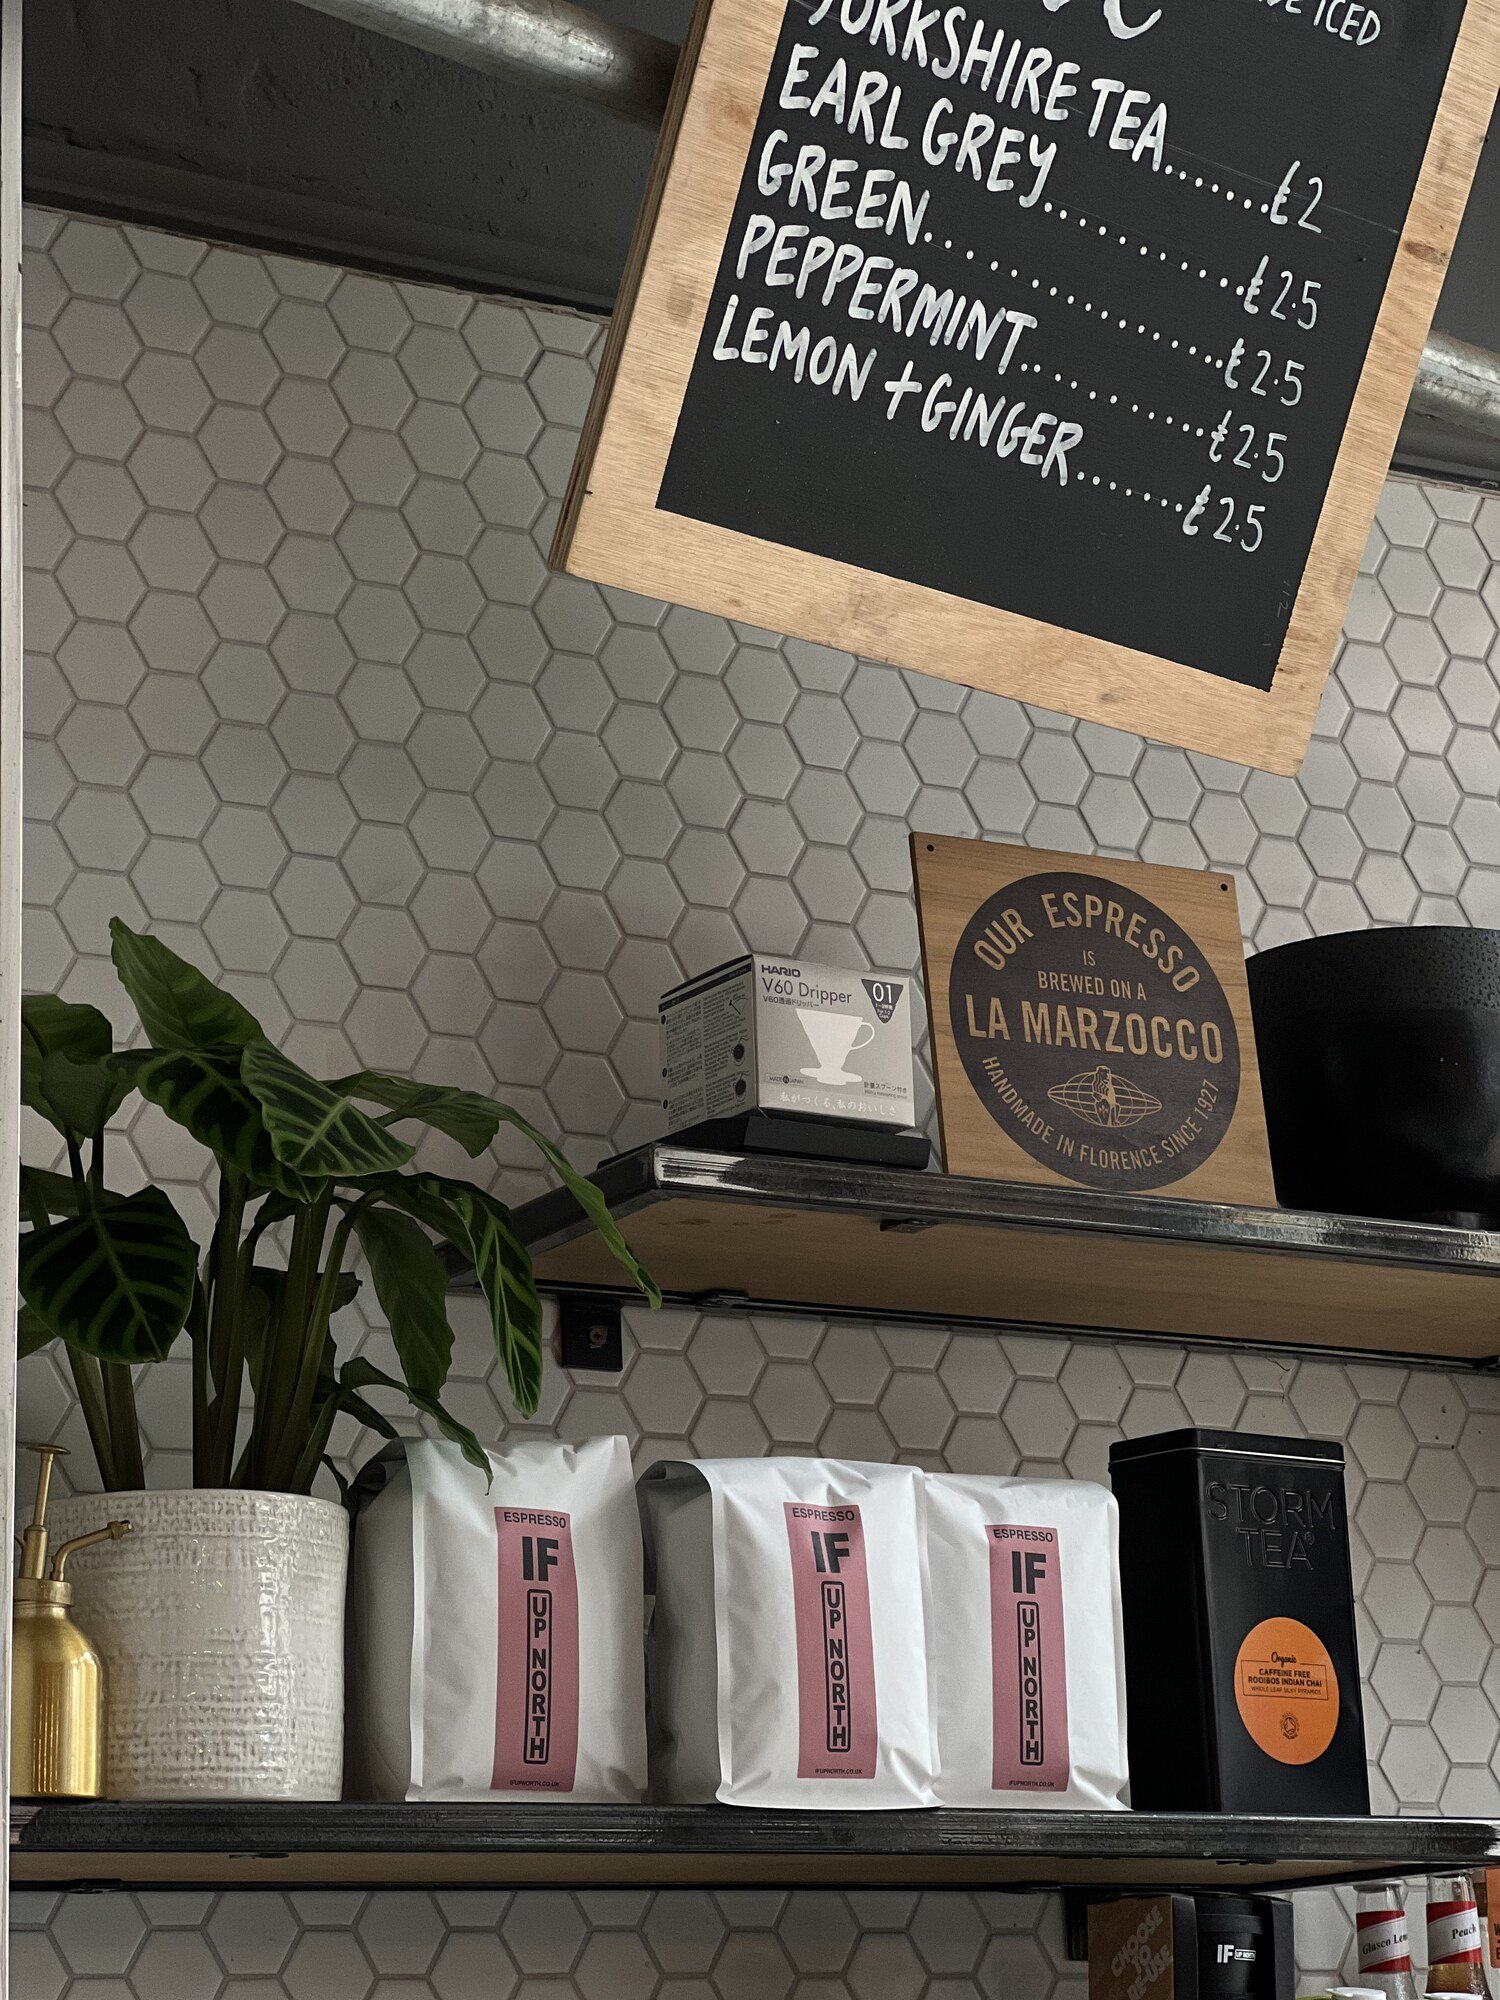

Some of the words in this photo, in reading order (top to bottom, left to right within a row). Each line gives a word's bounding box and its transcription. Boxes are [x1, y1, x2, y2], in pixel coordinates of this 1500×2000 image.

[1313, 0, 1381, 46] ICED
[779, 43, 909, 149] EARL
[922, 97, 1057, 207] GREY
[1091, 78, 1168, 172] TEA
[758, 129, 930, 245] GREEN
[736, 214, 1038, 375] PEPPERMINT
[712, 294, 877, 401] LEMON
[973, 908, 1035, 971] OUR
[1041, 891, 1201, 993] ESPRESSO
[1082, 950, 1096, 966] IS
[761, 964, 801, 978] HARIO
[762, 977, 793, 996] V60
[799, 982, 852, 1006] Dripper
[1037, 970, 1104, 996] BREWED
[1111, 979, 1131, 999] ON
[1137, 982, 1147, 1001] A
[872, 982, 893, 1004] 01
[965, 994, 1011, 1042] LA
[1021, 1000, 1224, 1064] MARZOCCO
[982, 1056, 1055, 1144] HANDMADE
[1056, 1134, 1073, 1158] IN
[1080, 1144, 1163, 1170] FLORENCE
[1162, 1117, 1203, 1159] SINCE
[1194, 1079, 1219, 1119] 1927
[504, 1510, 567, 1528] ESPRESSO
[792, 1507, 856, 1523] ESPRESSO
[1206, 1481, 1336, 1531] STORM
[811, 1530, 850, 1574] IF
[993, 1528, 1054, 1543] ESPRESSO
[522, 1535, 559, 1582] IF
[1011, 1550, 1047, 1595] IF
[531, 1596, 547, 1639] UP
[826, 1587, 841, 1630] UP
[1021, 1607, 1036, 1648] UP
[1258, 1668, 1293, 1678] CAFFEINE
[1294, 1670, 1311, 1679] FREE
[1271, 1651, 1297, 1668] Organic
[828, 1638, 848, 1748] NORTH
[1247, 1675, 1280, 1685] ROOIBOS
[1281, 1677, 1305, 1687] INDIAN
[1306, 1679, 1322, 1688] CHAI
[529, 1647, 547, 1760] NORTH
[1022, 1656, 1040, 1761] NORTH
[1111, 1905, 1164, 1977] CHOOSE
[1362, 1938, 1391, 1955] Glasco
[1451, 1923, 1477, 1940] Peach
[1131, 1945, 1152, 1974] TO
[1216, 1944, 1235, 1964] IF
